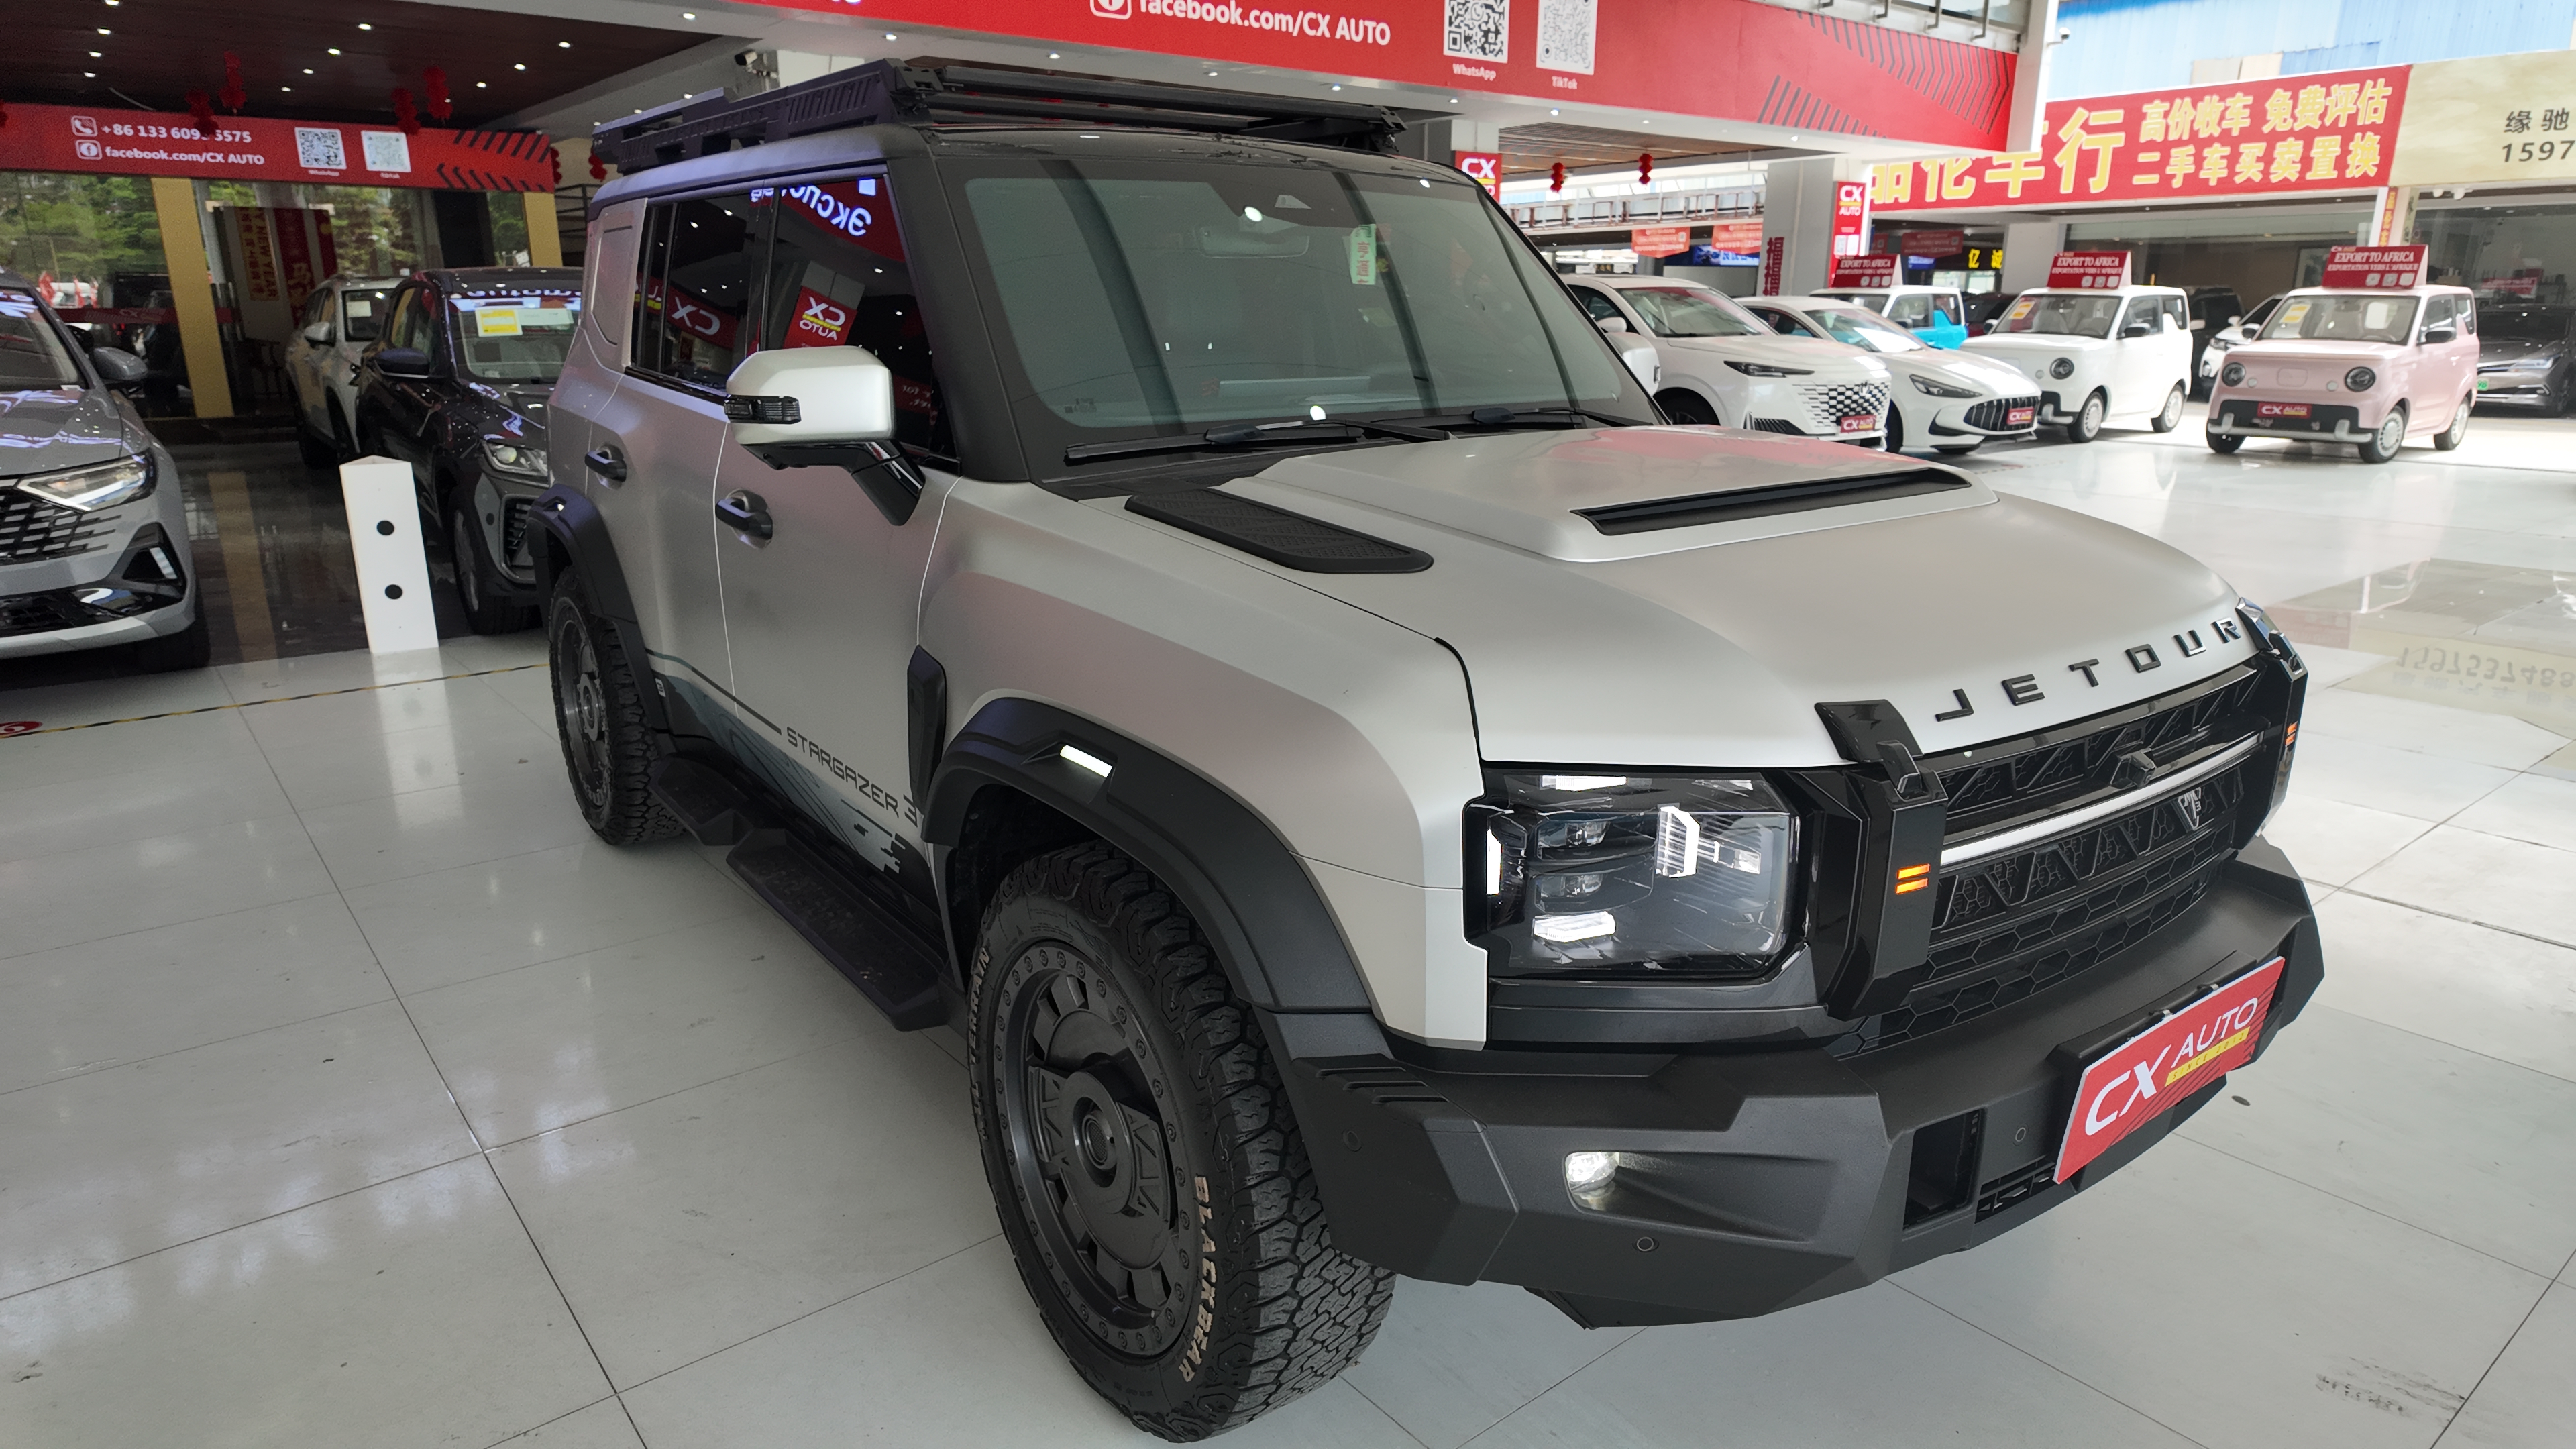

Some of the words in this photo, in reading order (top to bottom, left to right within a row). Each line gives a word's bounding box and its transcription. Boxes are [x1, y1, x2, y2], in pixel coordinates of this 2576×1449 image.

[1335, 17, 1391, 46] AUTO
[1452, 63, 1497, 81] WhatsApp
[1552, 76, 1578, 89] TikTok
[2139, 92, 2253, 143] 高价收车
[2261, 77, 2393, 134] 免费评估
[2503, 107, 2570, 133] 缘驰
[101, 123, 134, 136] +86
[137, 125, 168, 138] 133
[170, 127, 210, 141] 609
[105, 146, 225, 164] facebook.com/CX
[227, 154, 265, 165] AUTO
[2132, 132, 2381, 189] 二手车买卖置换
[2502, 140, 2576, 163] 1597
[1462, 157, 1497, 178] CX
[1839, 185, 1864, 201] CX
[1839, 207, 1862, 216] AUTO
[2057, 256, 2083, 266] EXPORT
[2084, 256, 2094, 266] TO
[2094, 256, 2120, 266] AFRICA
[2334, 252, 2368, 262] EXPORT
[2369, 252, 2381, 262] TO
[2381, 251, 2414, 262] AFRICA
[2009, 411, 2021, 421] CX
[2261, 405, 2283, 415] CX
[1843, 419, 1859, 431] CX
[1934, 616, 2242, 722] JETOUR
[786, 726, 900, 818] STARGAZER
[2172, 1053, 2208, 1080] SINCE
[2216, 1032, 2245, 1054] 2012
[2084, 1043, 2172, 1136] CX
[2170, 997, 2258, 1069] AUTO
